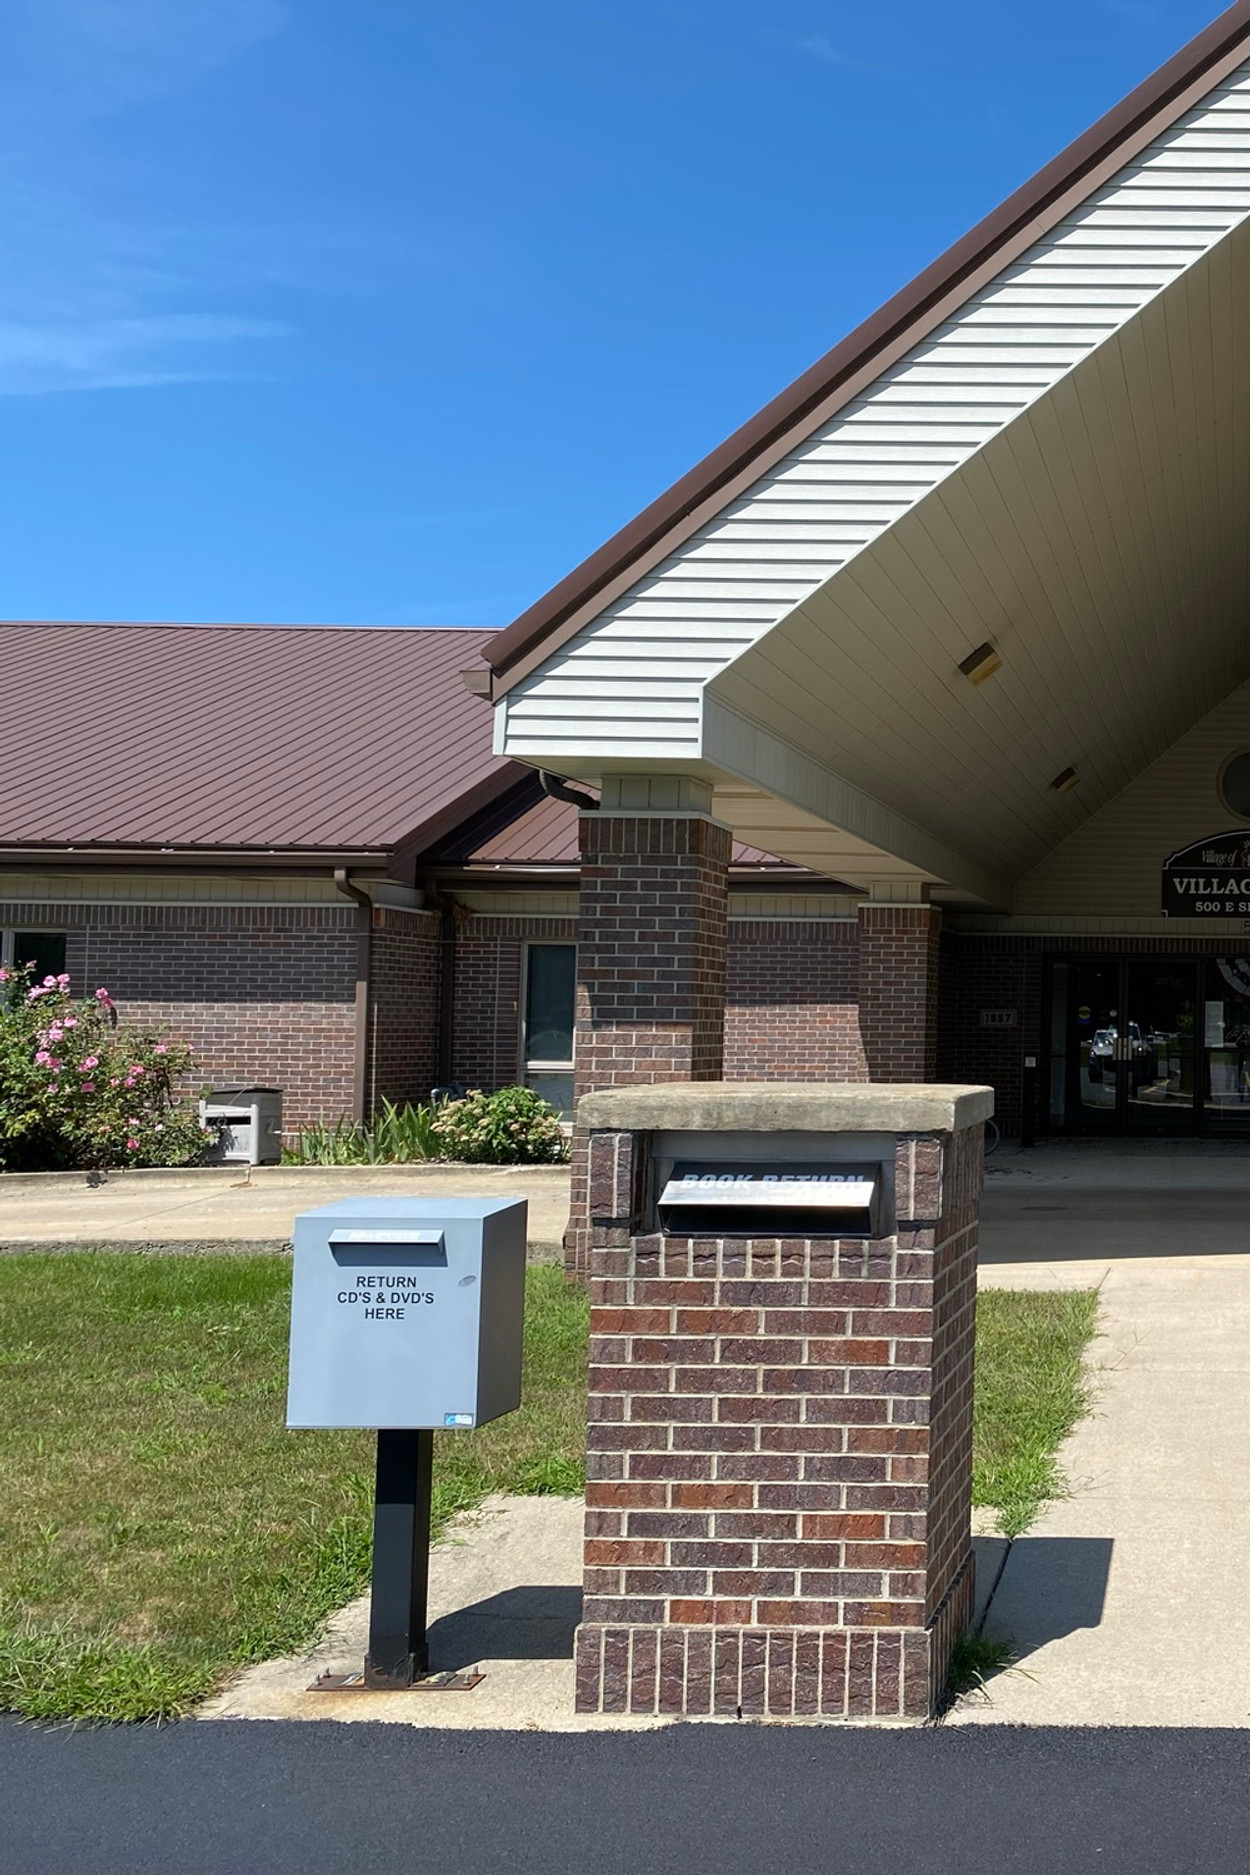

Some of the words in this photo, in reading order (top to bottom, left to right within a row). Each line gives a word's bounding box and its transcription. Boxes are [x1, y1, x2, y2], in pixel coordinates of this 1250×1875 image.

[1202, 850, 1227, 867] Village
[1227, 849, 1238, 867] of
[1195, 902, 1221, 913] 500
[1225, 902, 1234, 913] E
[985, 1013, 1012, 1023] 1997
[680, 1174, 754, 1190] BOOK
[356, 1276, 417, 1288] RETURN
[337, 1292, 372, 1304] CD'S
[376, 1292, 386, 1304] &
[391, 1292, 435, 1304] DVD'S
[364, 1308, 405, 1320] HERE
